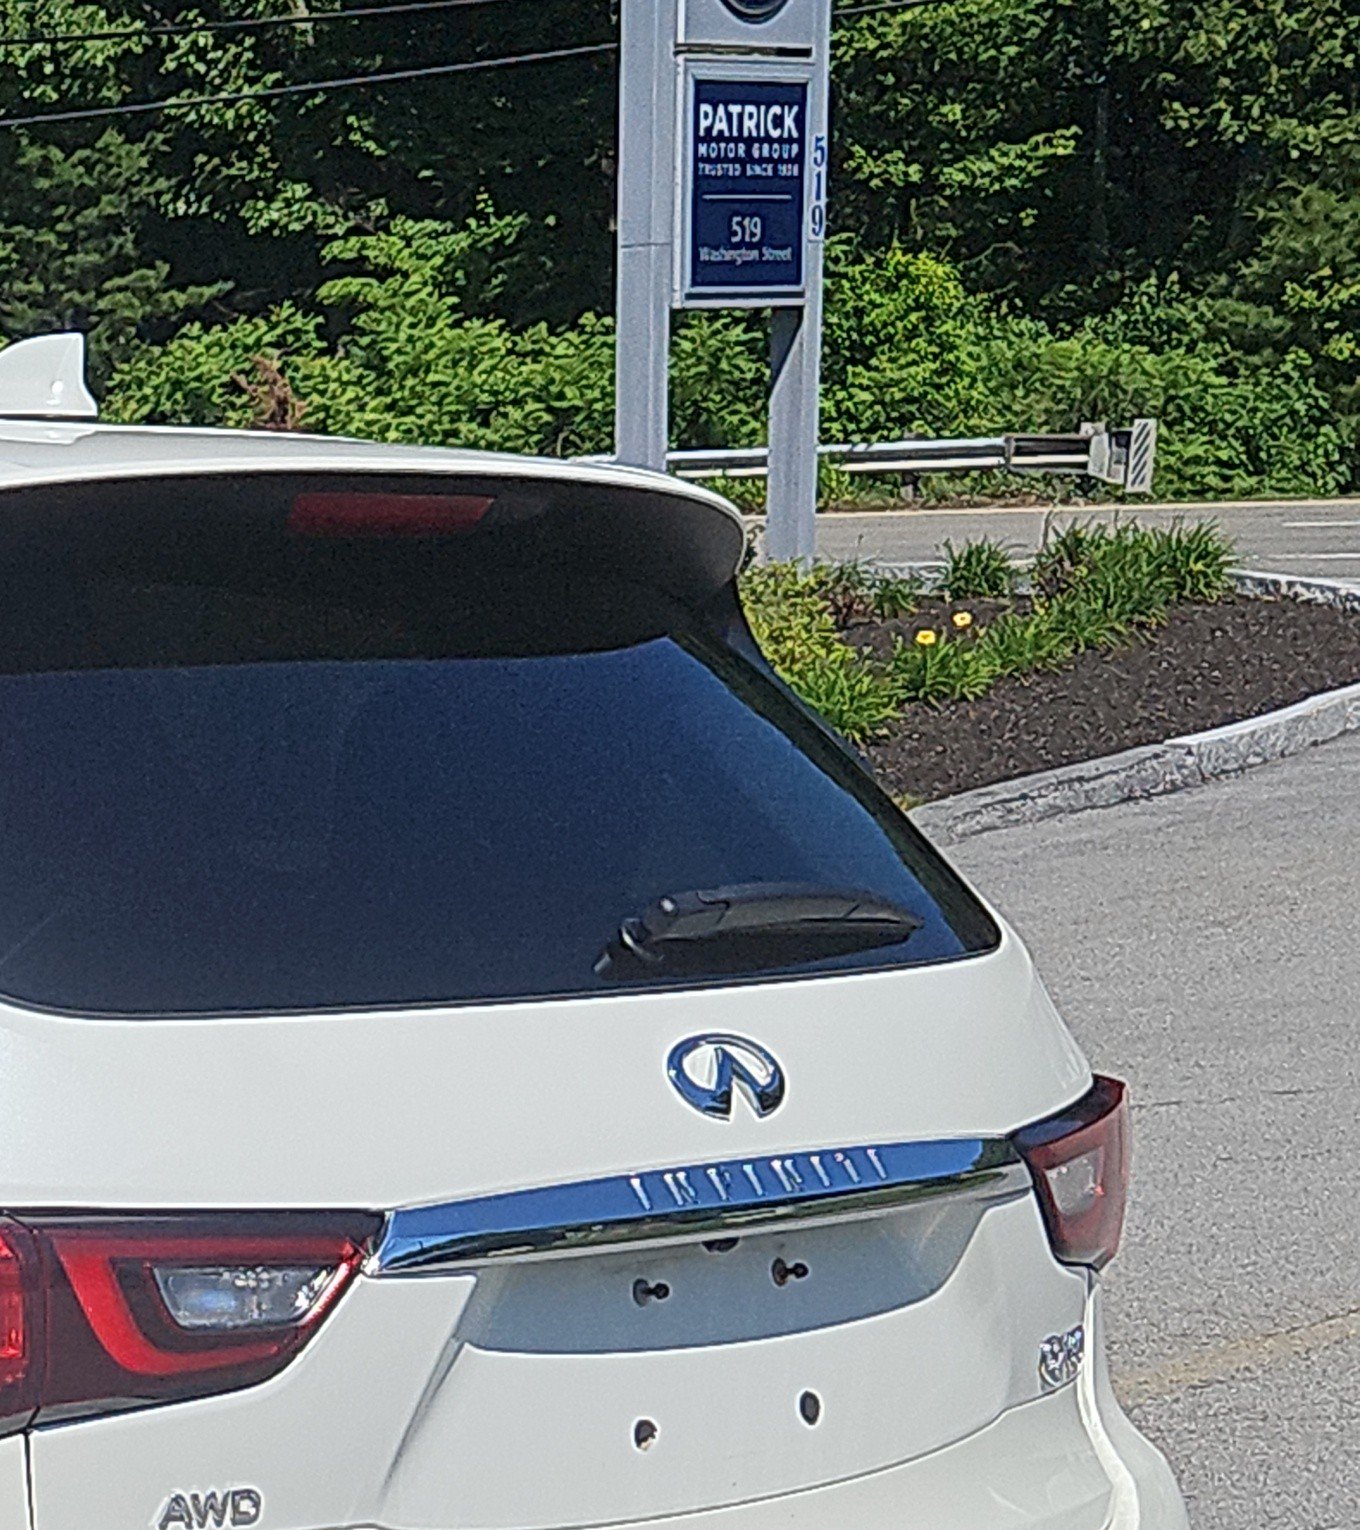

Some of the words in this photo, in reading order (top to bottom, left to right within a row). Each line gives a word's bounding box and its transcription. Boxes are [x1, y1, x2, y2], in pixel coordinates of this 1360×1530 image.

[698, 103, 800, 138] PATRICK
[697, 142, 746, 159] MOTOR
[751, 142, 799, 160] GROUP
[812, 136, 826, 237] 519
[730, 216, 762, 243] 519
